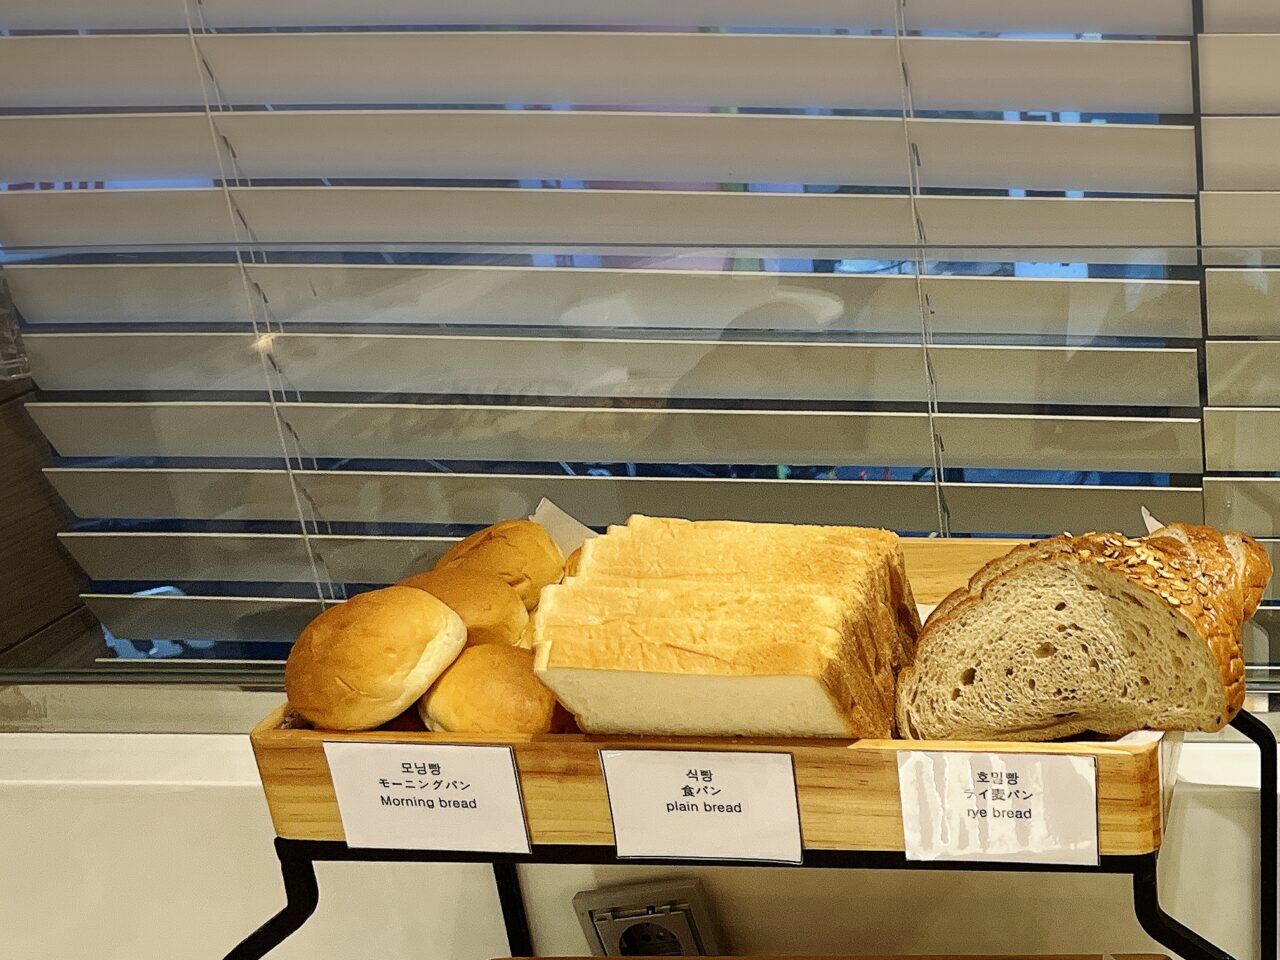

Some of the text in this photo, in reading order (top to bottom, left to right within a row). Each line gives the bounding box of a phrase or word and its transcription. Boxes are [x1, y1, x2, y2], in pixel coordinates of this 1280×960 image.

[401, 762, 441, 776] 모닝빵
[686, 768, 714, 782] 식빵
[977, 772, 1020, 786] 호밀빵
[380, 795, 477, 809] Morning bread
[666, 801, 742, 813] plain bread
[967, 807, 1032, 820] rye bread
